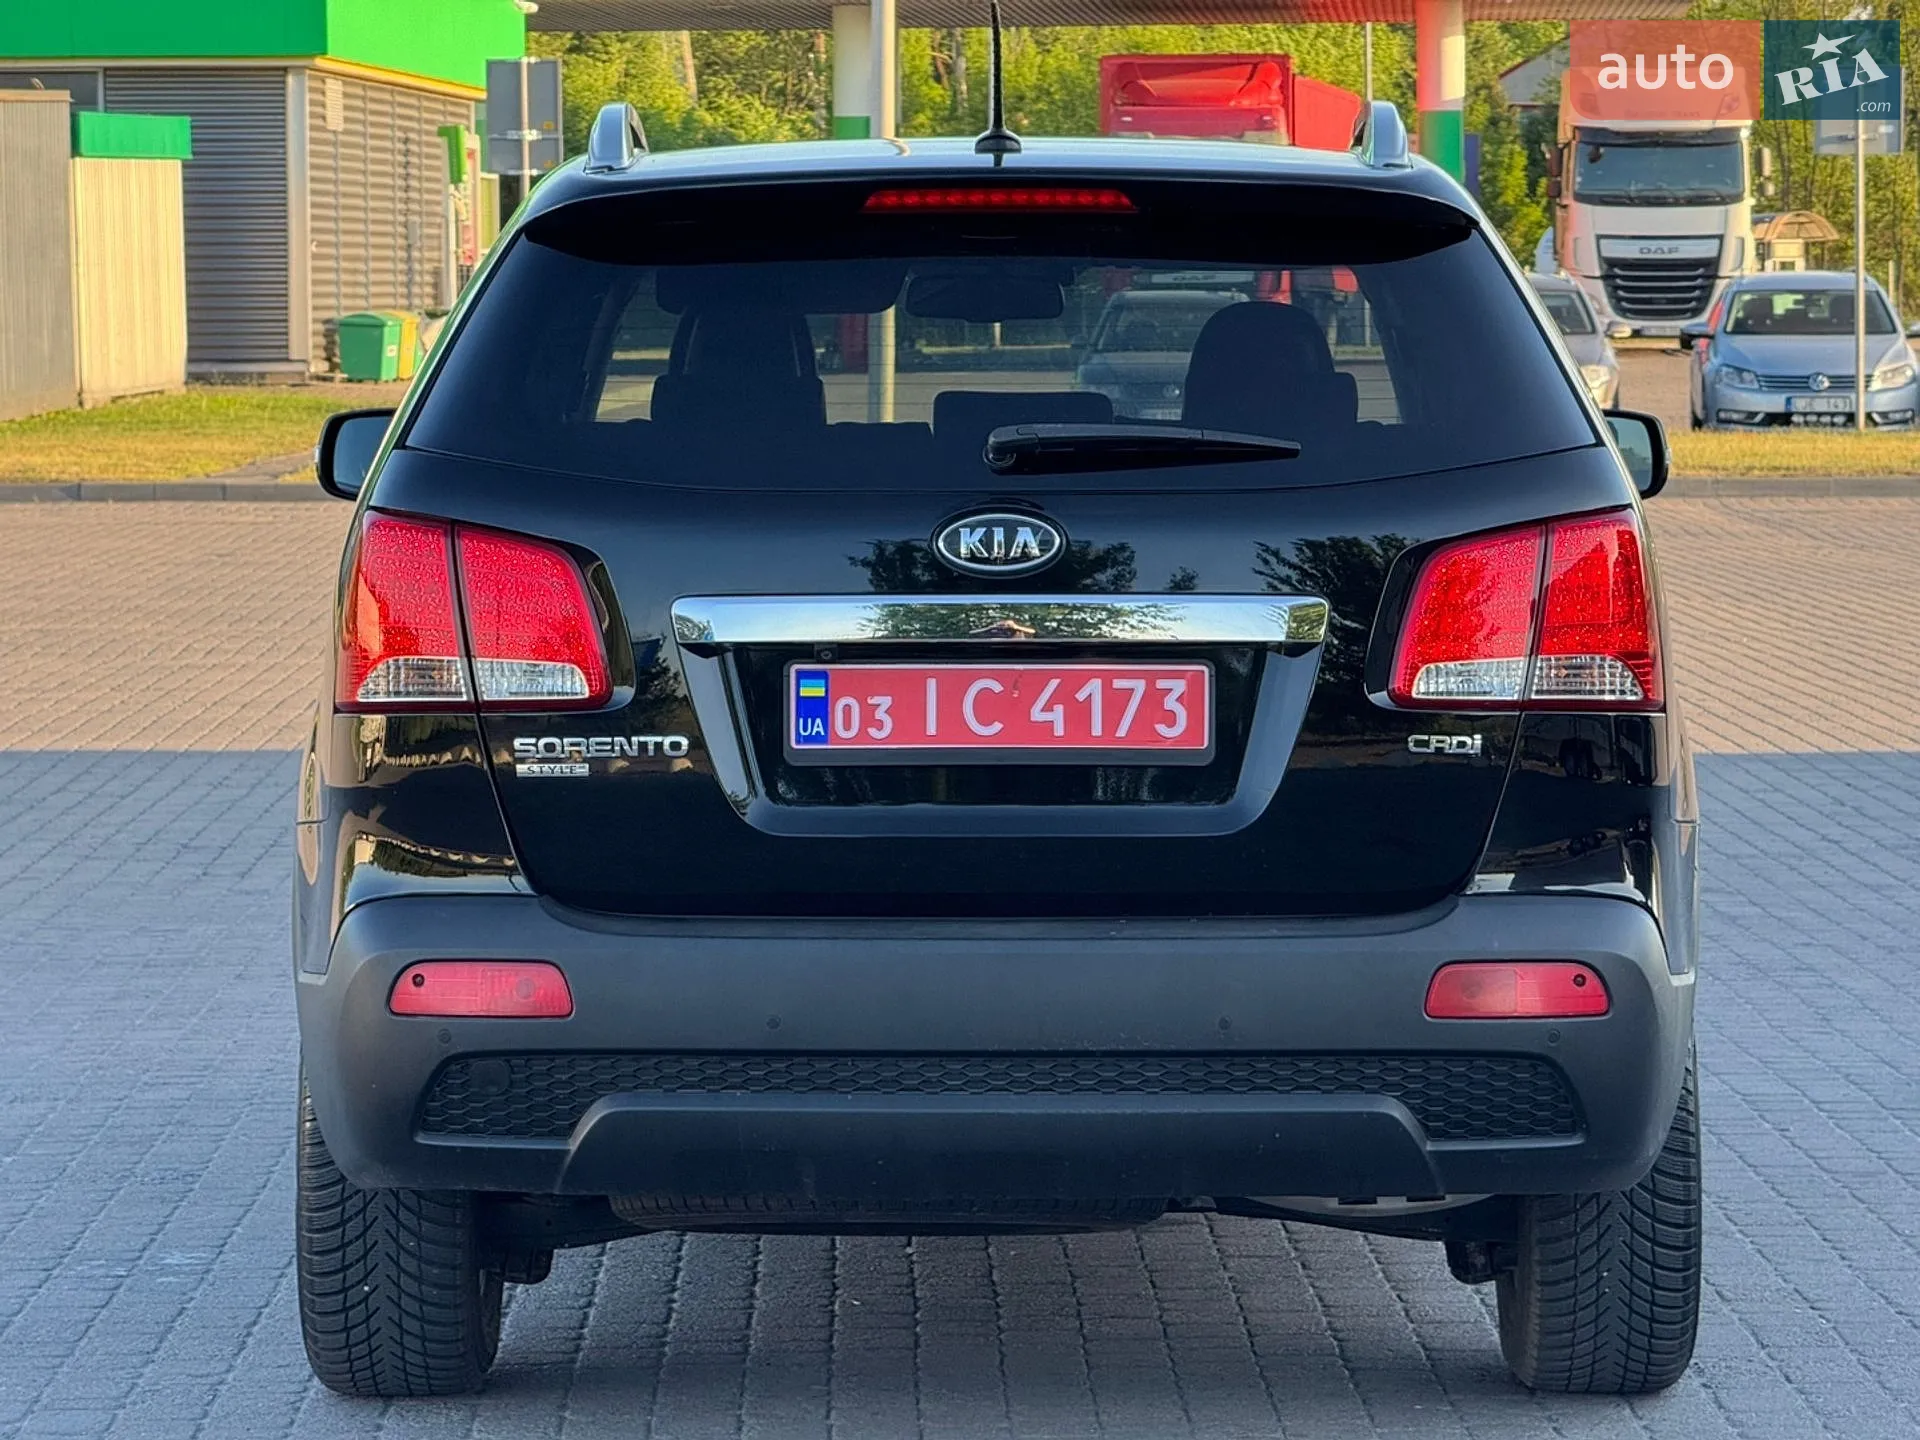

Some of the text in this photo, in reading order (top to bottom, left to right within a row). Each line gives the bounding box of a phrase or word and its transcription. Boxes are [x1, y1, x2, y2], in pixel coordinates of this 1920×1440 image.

[1638, 246, 1680, 255] DAF
[958, 526, 1041, 559] KIA
[799, 677, 1188, 740] UA 03 IC 4173
[512, 735, 690, 759] SORENTO
[526, 765, 579, 776] STYLE
